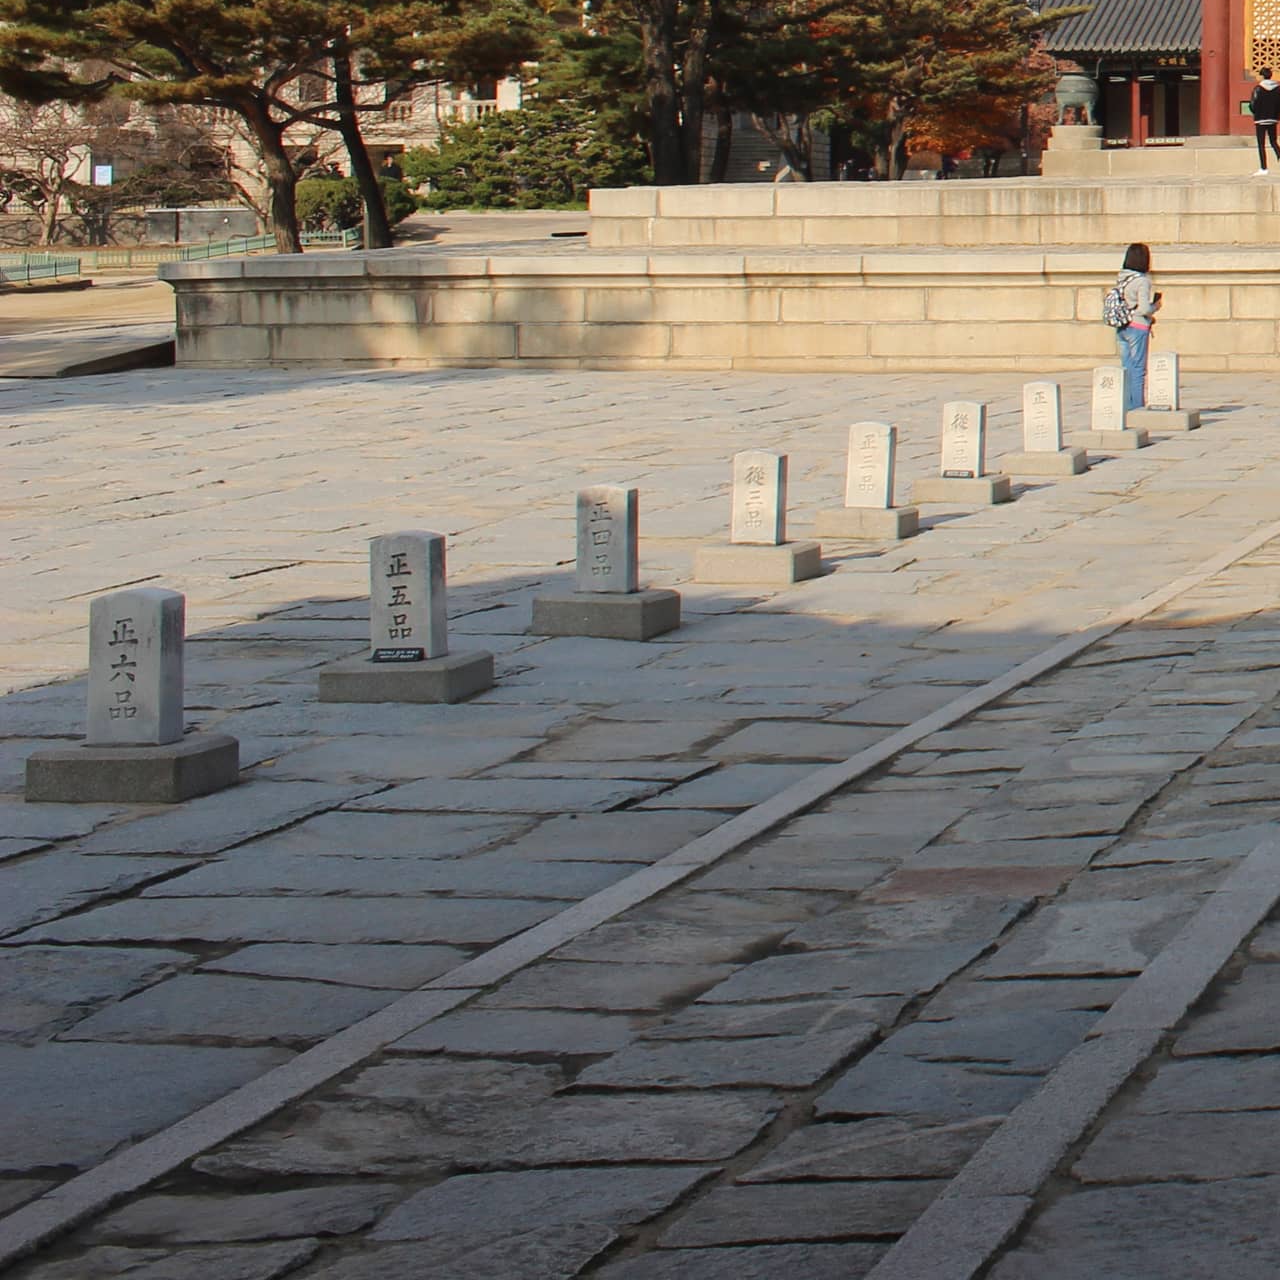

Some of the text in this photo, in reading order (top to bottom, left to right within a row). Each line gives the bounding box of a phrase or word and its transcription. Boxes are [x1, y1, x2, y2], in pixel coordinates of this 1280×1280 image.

[744, 464, 766, 529] 從三品
[859, 432, 878, 495] 正三品
[589, 501, 614, 577] 正四品
[385, 552, 413, 640] 正五品
[107, 617, 139, 721] 正六品
